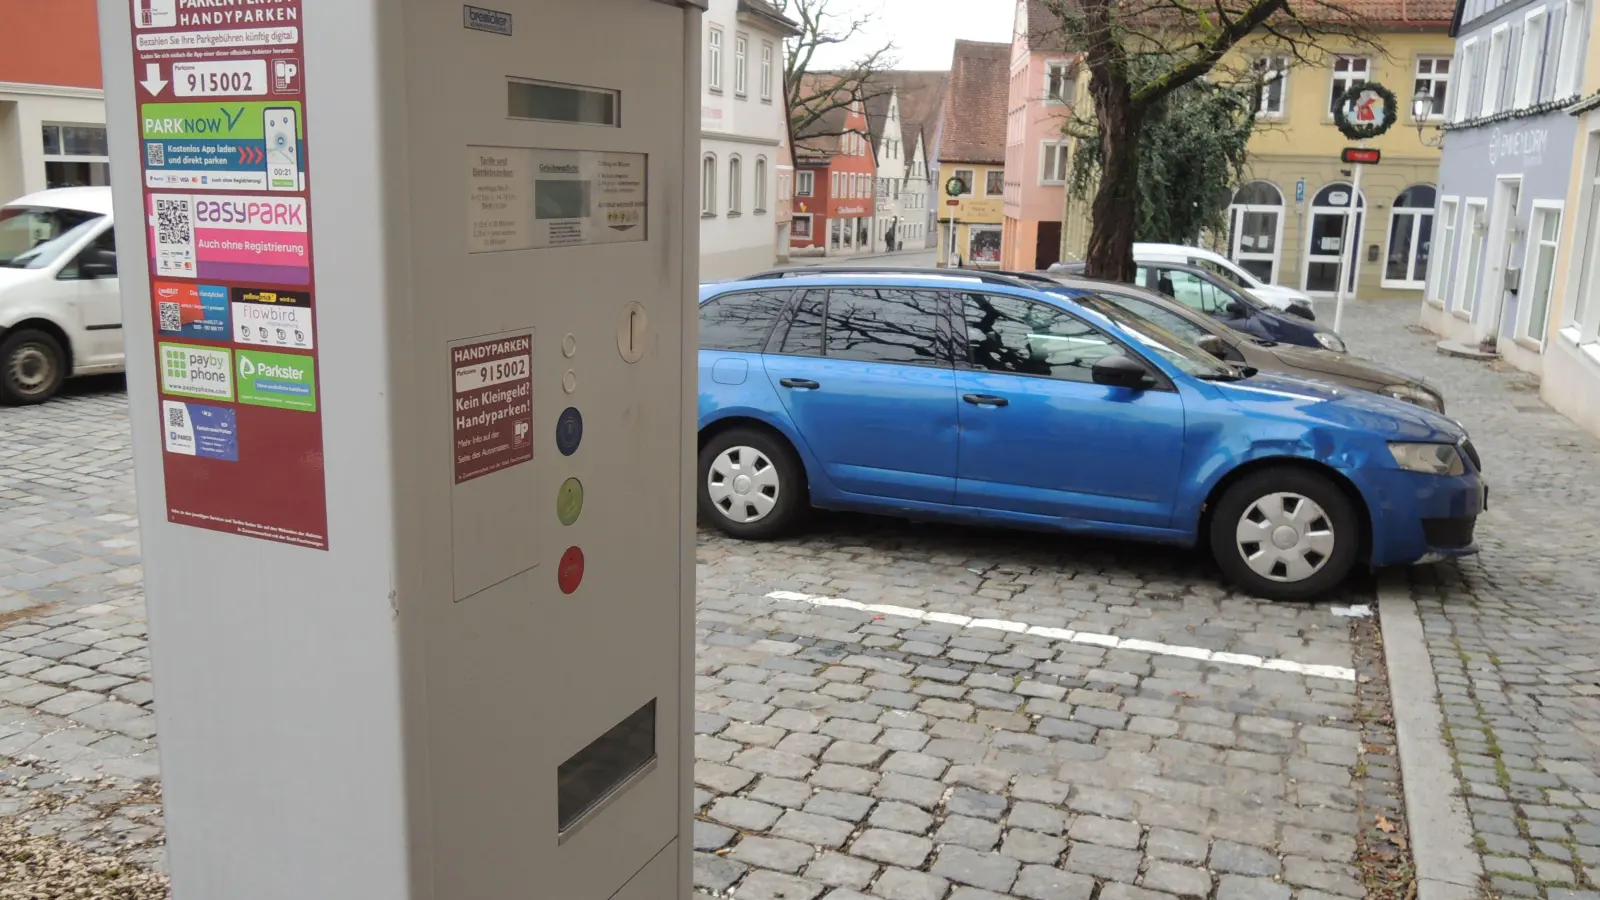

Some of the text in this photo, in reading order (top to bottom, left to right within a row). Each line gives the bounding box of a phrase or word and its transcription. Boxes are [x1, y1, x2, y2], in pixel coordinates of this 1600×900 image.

[180, 7, 297, 26] HANDYPARKEN
[139, 30, 295, 46] Bezahlen Sie Ihre Parkgebühren künftig digital.
[187, 72, 252, 92] 915002
[168, 145, 236, 155] Kostenlos App laden
[168, 156, 228, 166] und direkt parken
[198, 240, 304, 256] Auch ohne Registrierung
[454, 338, 529, 363] HANDYPARKEN
[190, 352, 224, 370] payby
[190, 369, 226, 382] phone
[258, 362, 304, 380] Parkster
[480, 359, 526, 382] 915002
[168, 383, 227, 395] www.paybyphone.com
[456, 382, 530, 412] Kein Kleingeld?
[456, 400, 530, 431] Handyparken!
[458, 438, 472, 448] Mehr
[482, 432, 492, 442] auf
